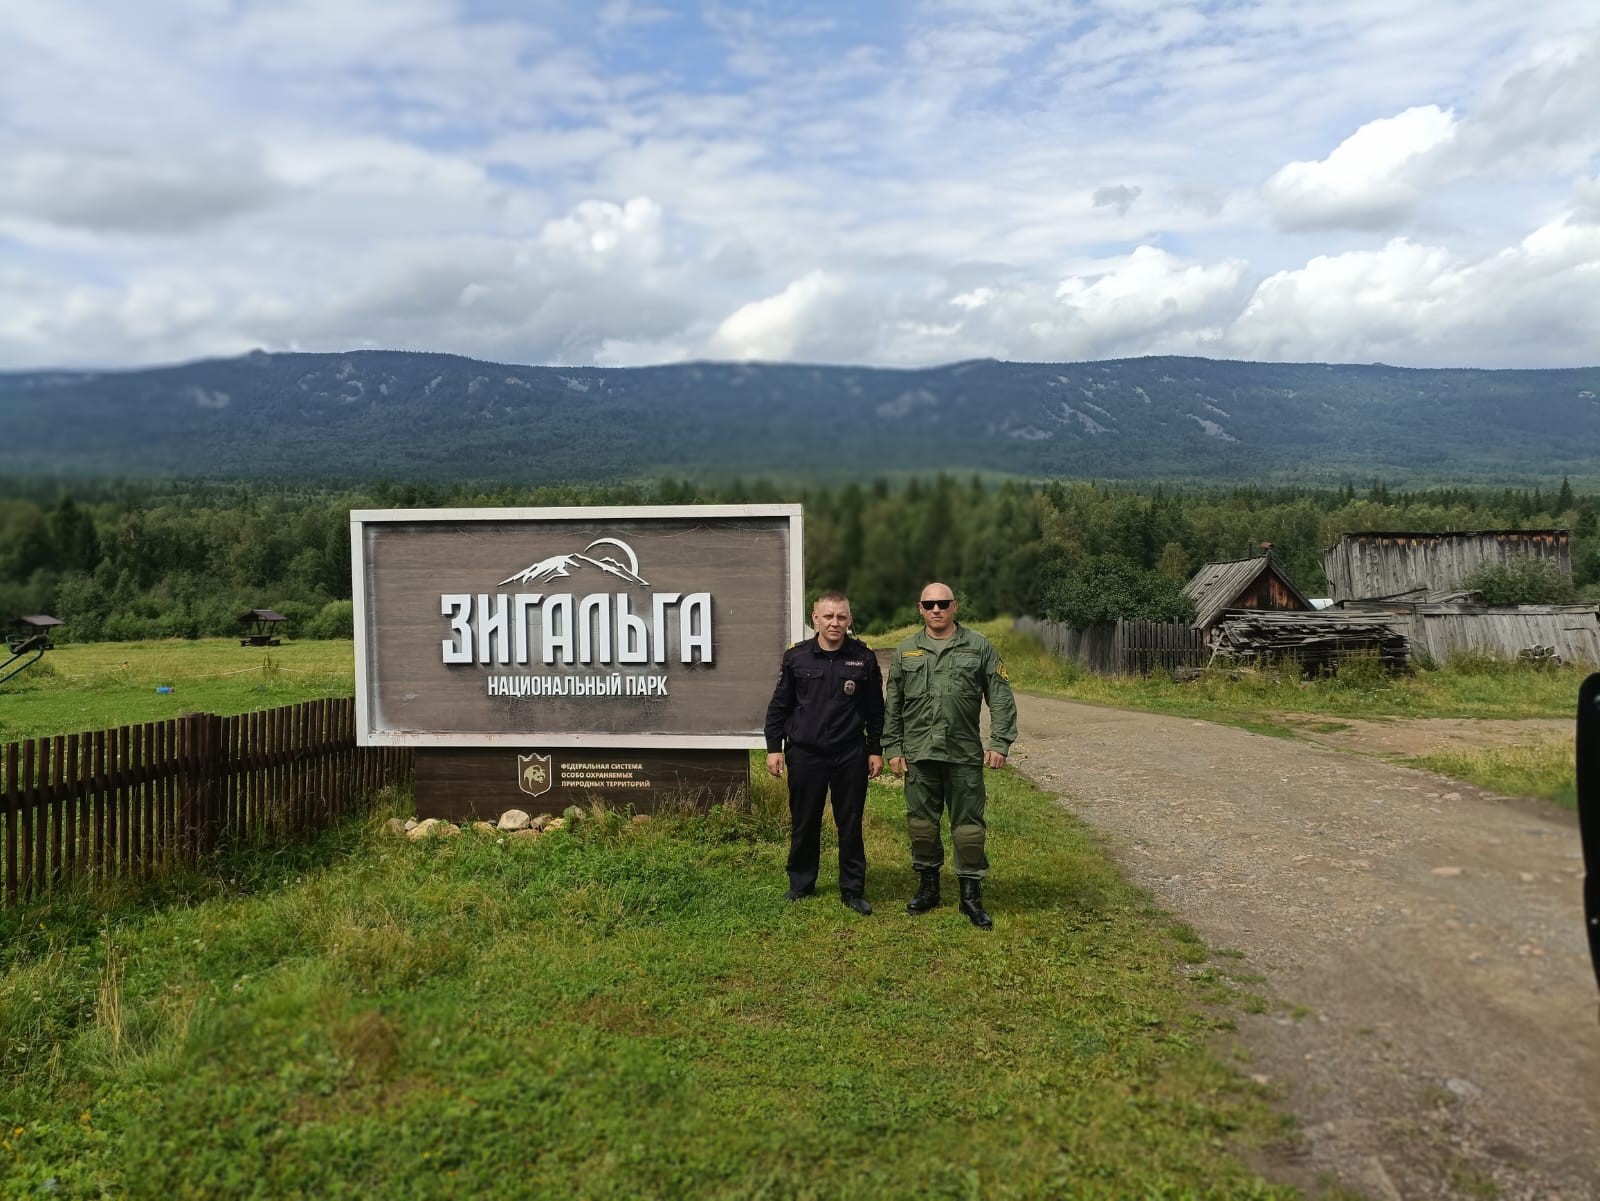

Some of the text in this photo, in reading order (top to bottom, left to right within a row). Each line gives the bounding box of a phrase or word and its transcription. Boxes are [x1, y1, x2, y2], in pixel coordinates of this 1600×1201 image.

[441, 592, 712, 664] ЗИГАЛЬГА
[487, 673, 668, 698] НАЦИОНАЛЬНЫЙ ПАРК
[560, 763, 609, 771] ФЕДЕРАЛЬНАЯ
[606, 780, 650, 788] ТЕРРИТОРИЙ
